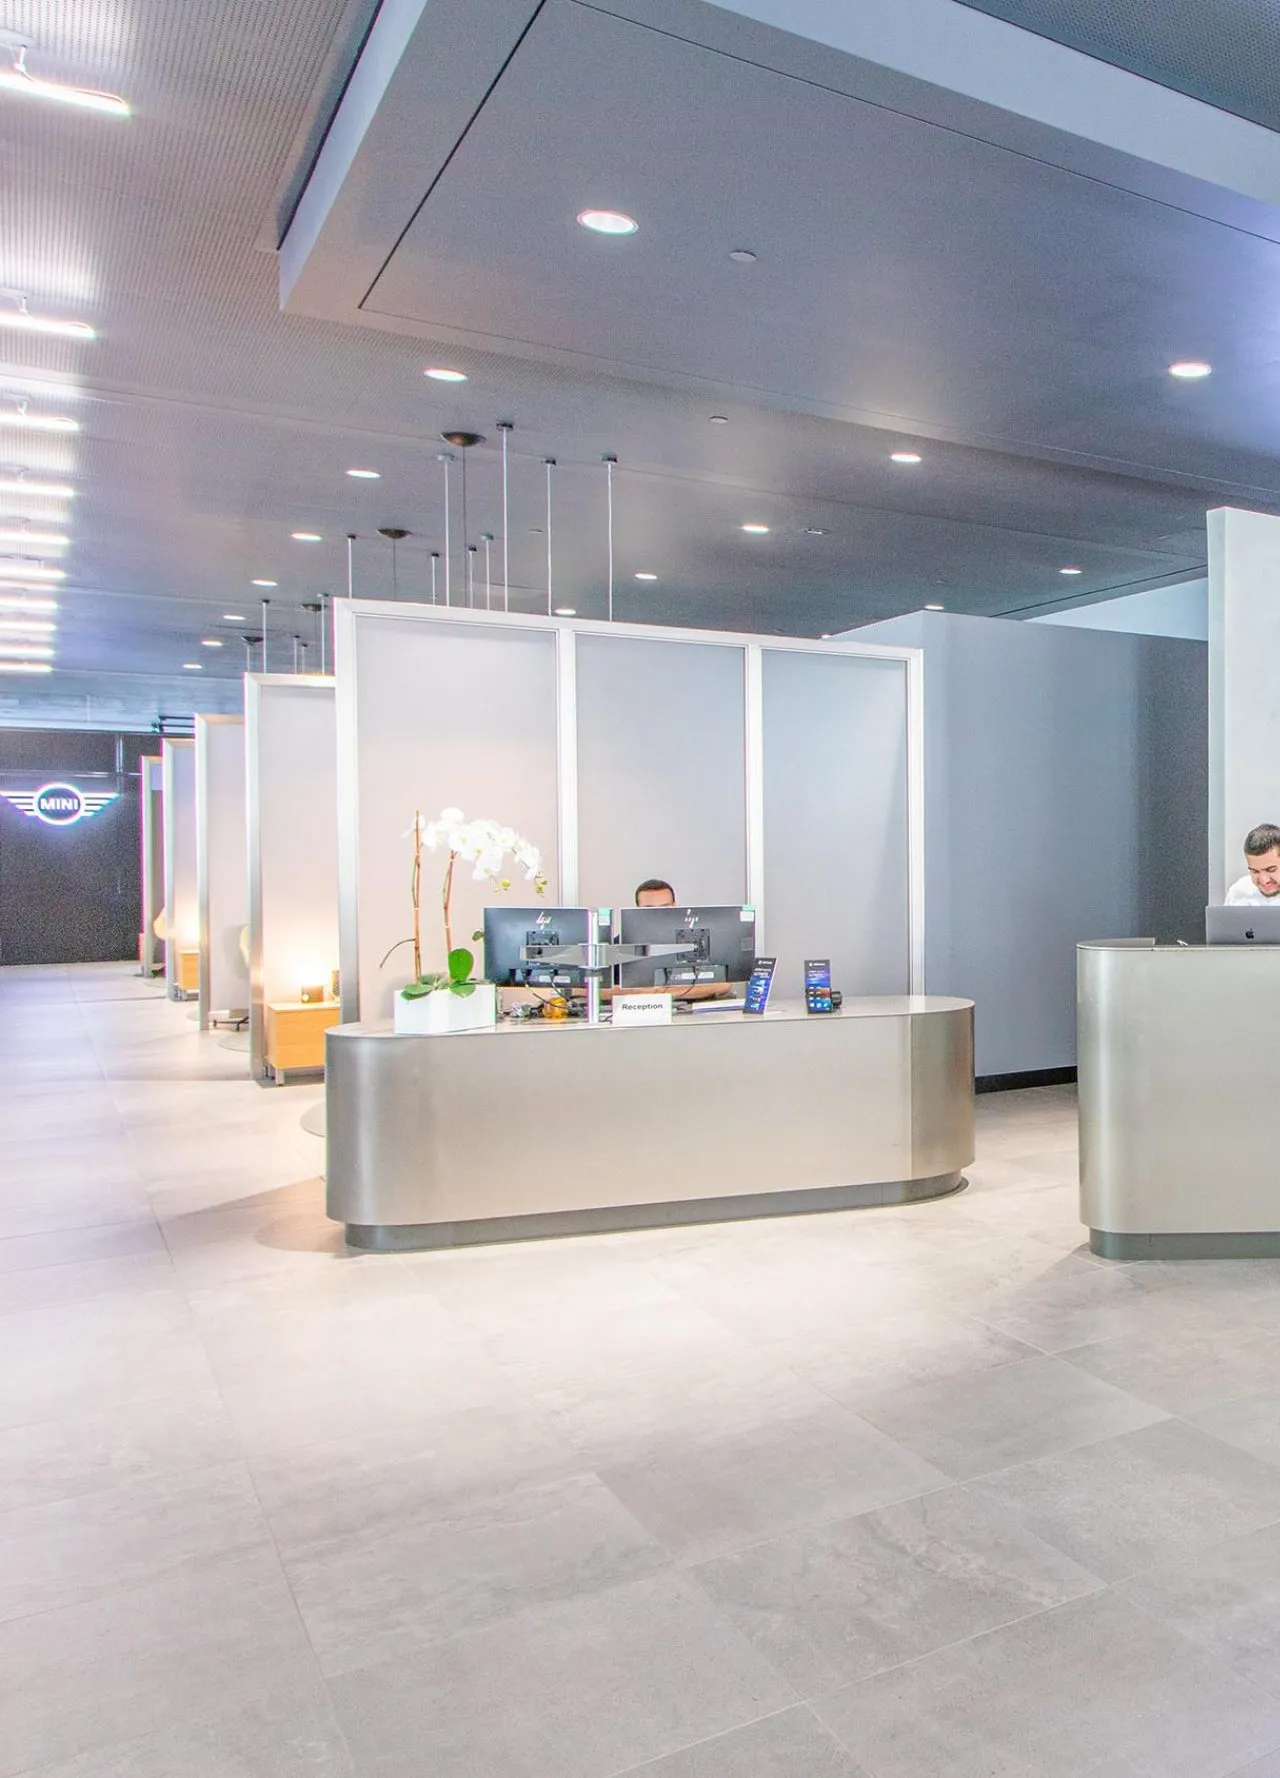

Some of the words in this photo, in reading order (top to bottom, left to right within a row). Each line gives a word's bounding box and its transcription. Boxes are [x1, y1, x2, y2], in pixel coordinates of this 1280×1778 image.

[40, 797, 79, 811] MINI
[536, 911, 552, 929] hp
[621, 1003, 664, 1011] Reception
